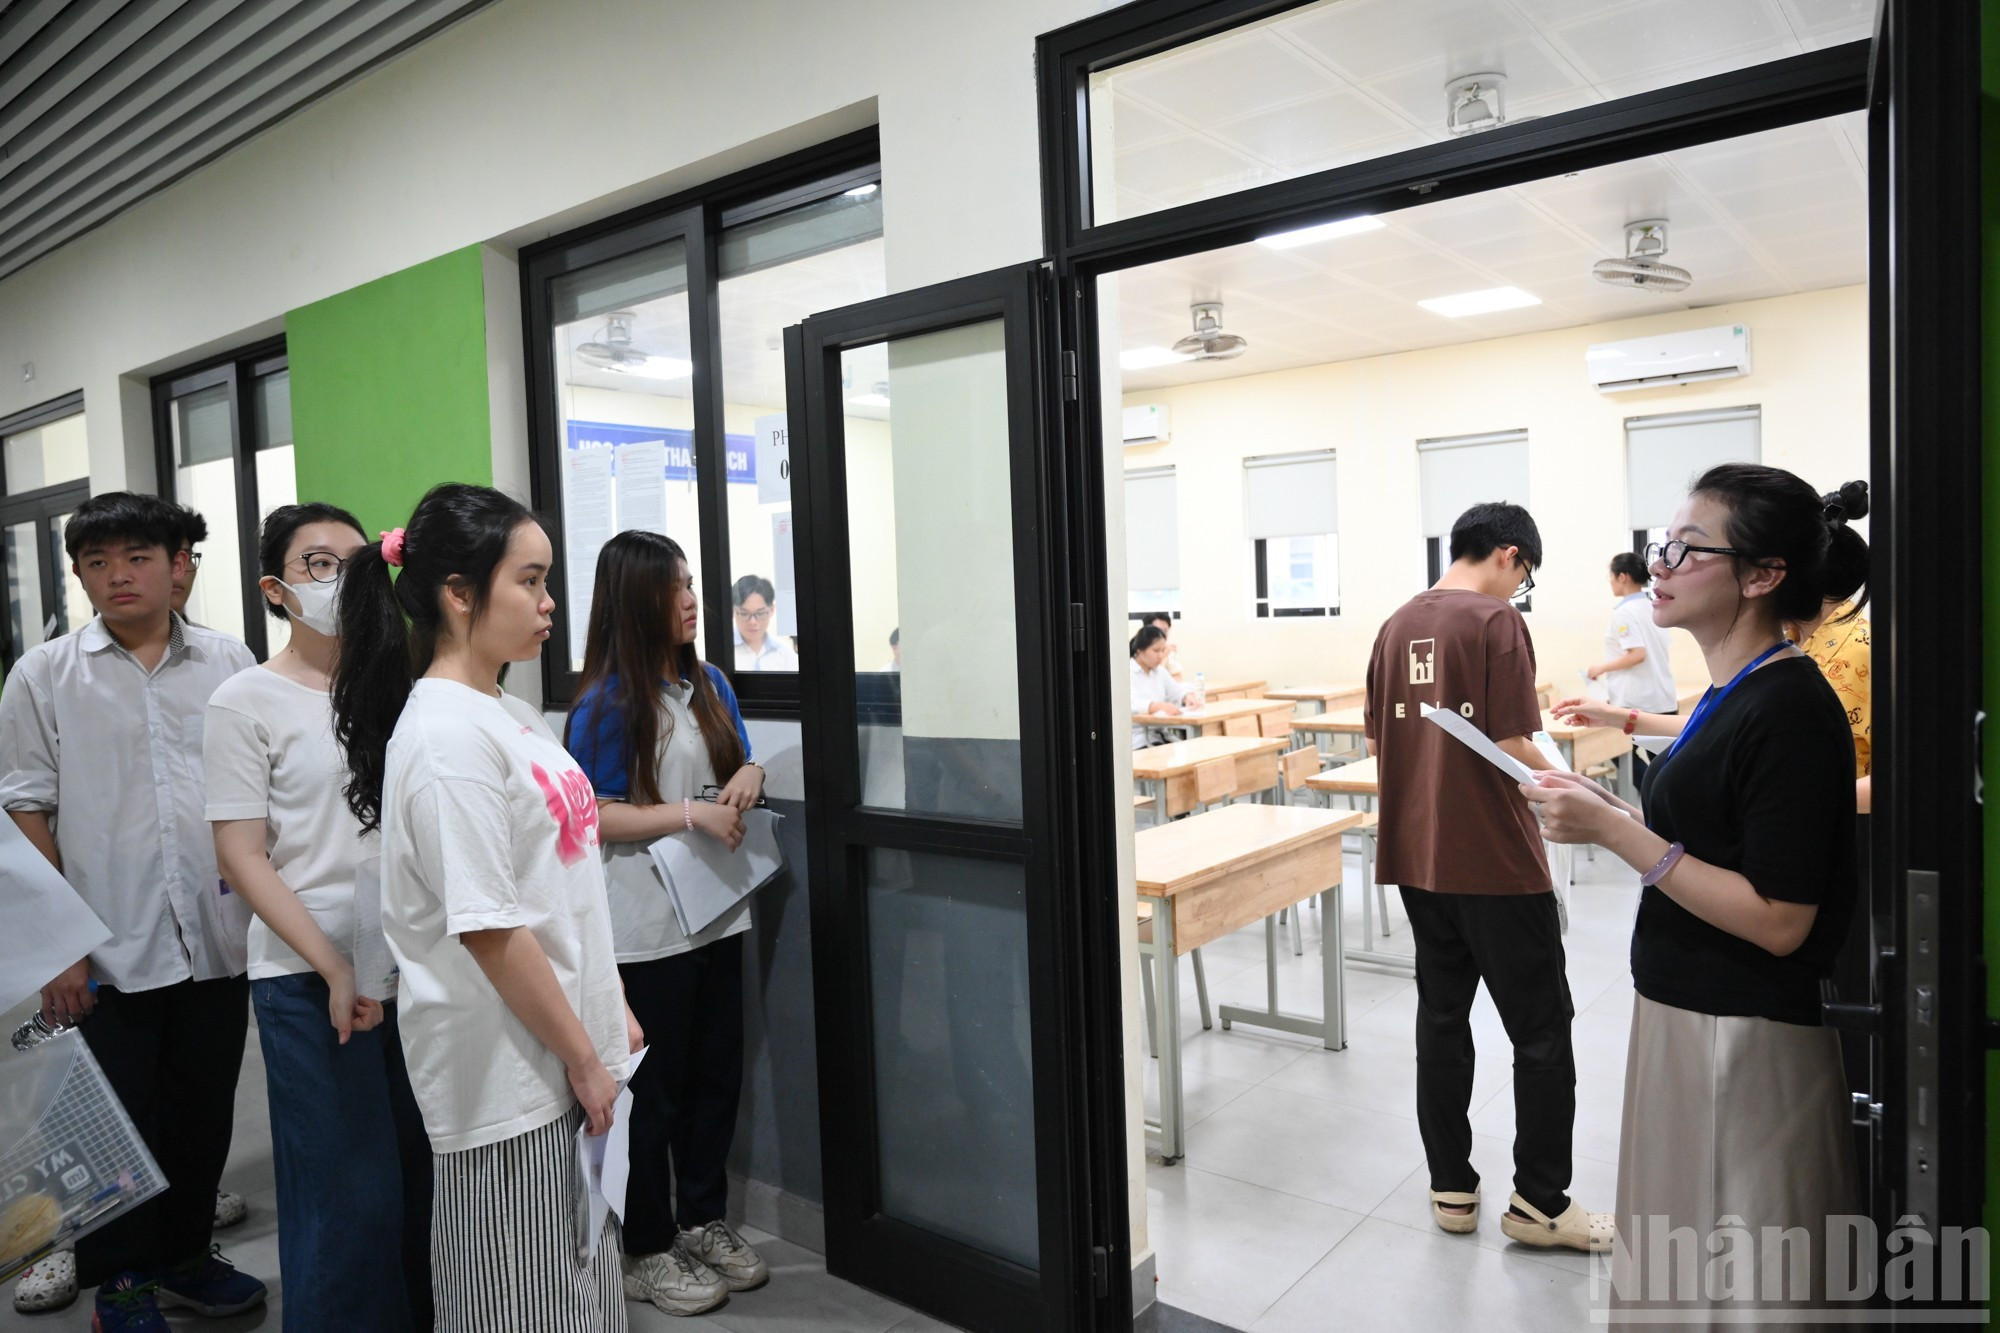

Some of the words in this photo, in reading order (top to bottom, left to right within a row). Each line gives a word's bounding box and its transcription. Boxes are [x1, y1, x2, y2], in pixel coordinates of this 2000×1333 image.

[772, 429, 789, 446] PH
[664, 446, 692, 468] THA
[780, 459, 790, 480] 0
[1410, 652, 1434, 683] hi
